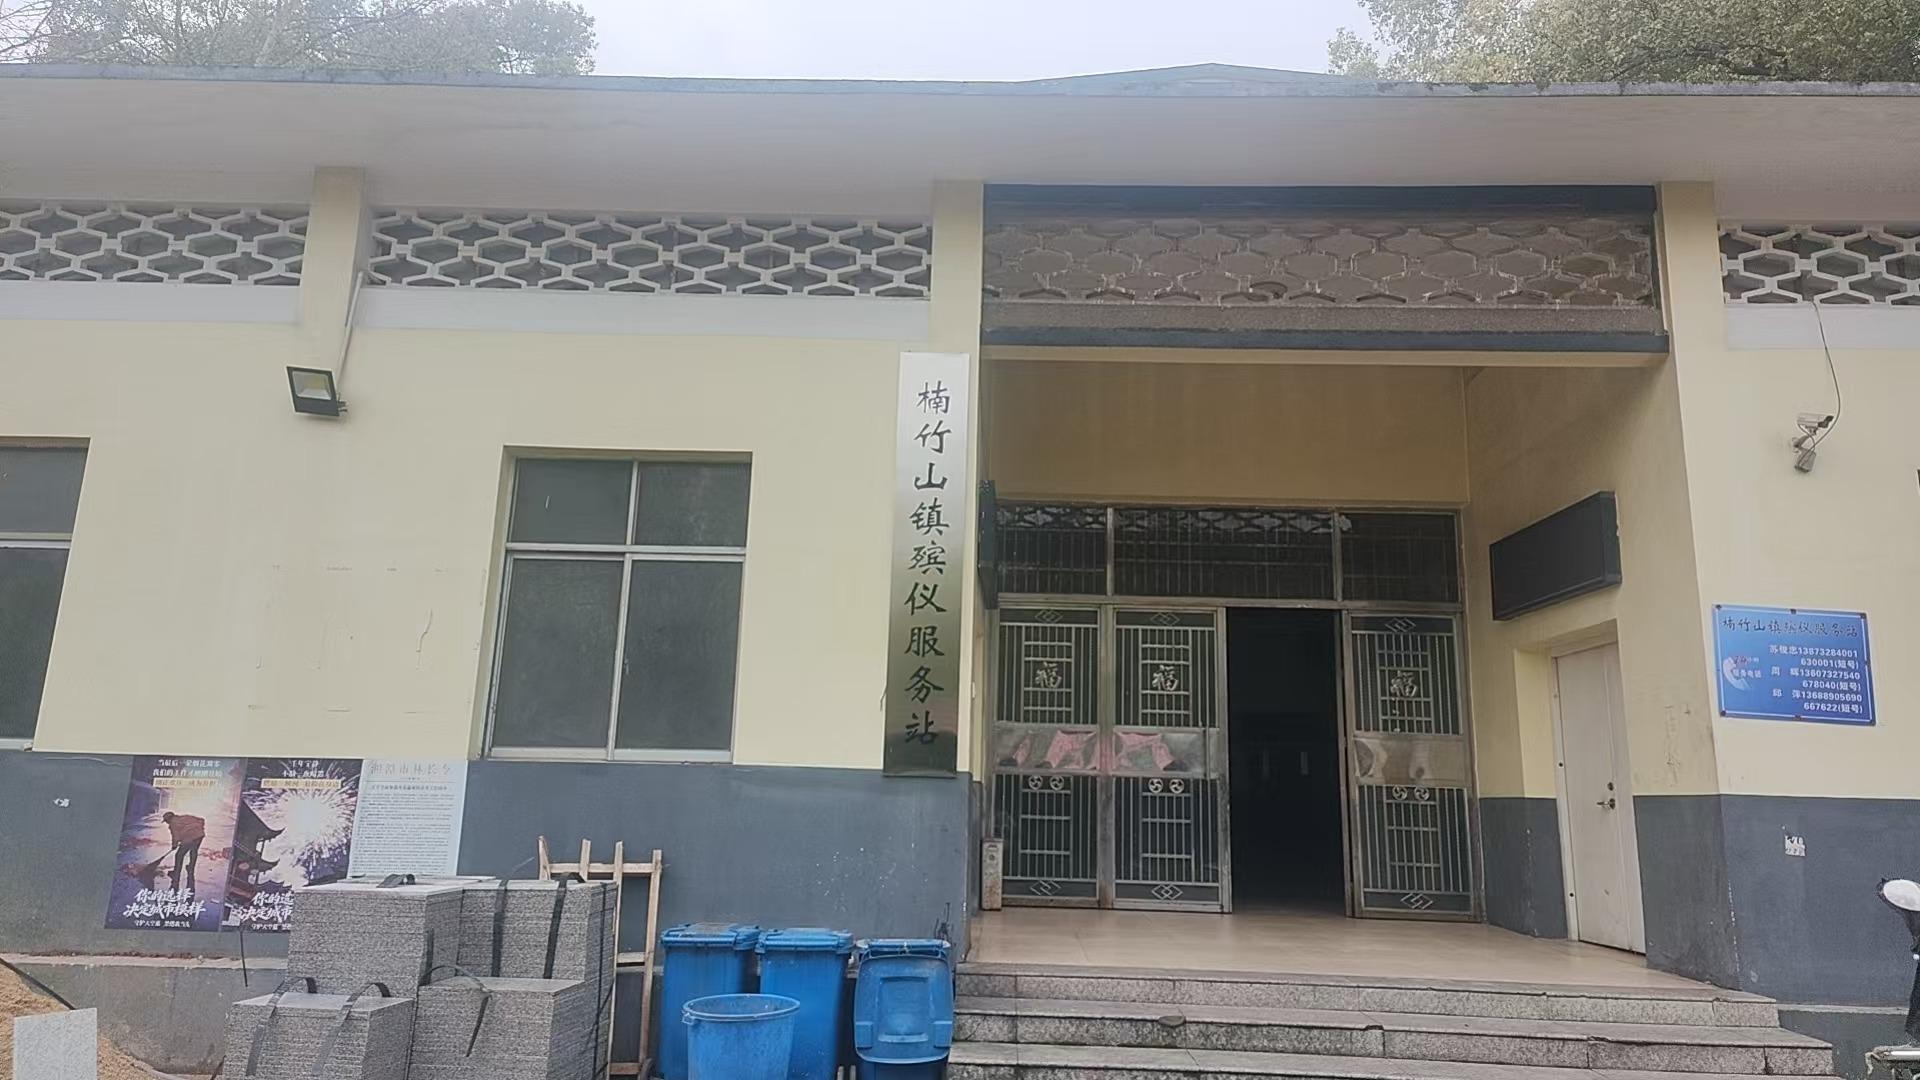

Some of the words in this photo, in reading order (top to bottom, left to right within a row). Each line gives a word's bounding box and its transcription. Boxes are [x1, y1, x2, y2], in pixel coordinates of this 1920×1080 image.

[903, 380, 953, 746] 楠竹山镇殡仪服务站
[1034, 661, 1063, 690] 福
[1152, 664, 1180, 693] 福
[1390, 670, 1418, 699] 福
[134, 887, 196, 903] 你的选择
[122, 900, 207, 921] 决定城市模样
